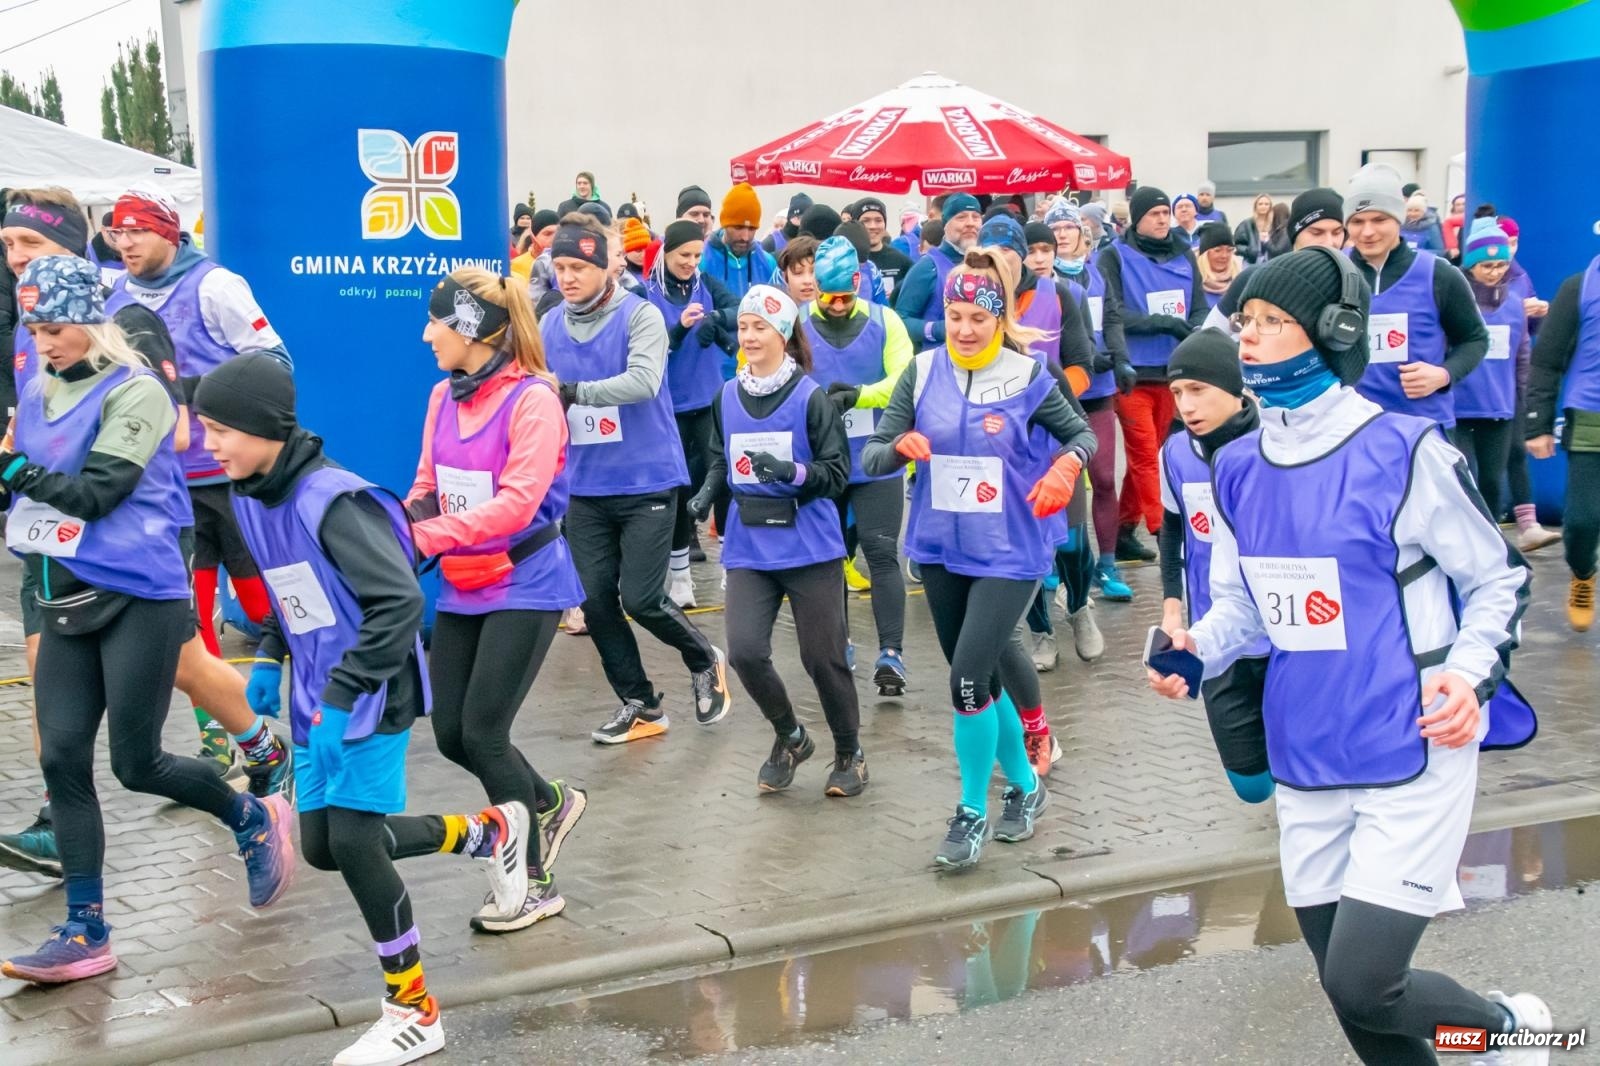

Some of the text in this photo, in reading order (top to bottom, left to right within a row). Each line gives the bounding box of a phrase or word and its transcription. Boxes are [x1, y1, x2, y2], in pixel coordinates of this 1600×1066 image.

[842, 109, 900, 155] WARKA
[945, 106, 993, 157] WARKA
[850, 165, 893, 182] Classic
[926, 167, 1050, 185] WARKA Classic
[291, 256, 366, 275] GMINA
[339, 287, 422, 299] odkryj poznaj
[1162, 303, 1177, 314] 65
[585, 416, 595, 432] 9
[958, 477, 971, 498] 7
[448, 494, 467, 513] 68
[28, 520, 59, 541] 67
[1267, 592, 1301, 626] 31
